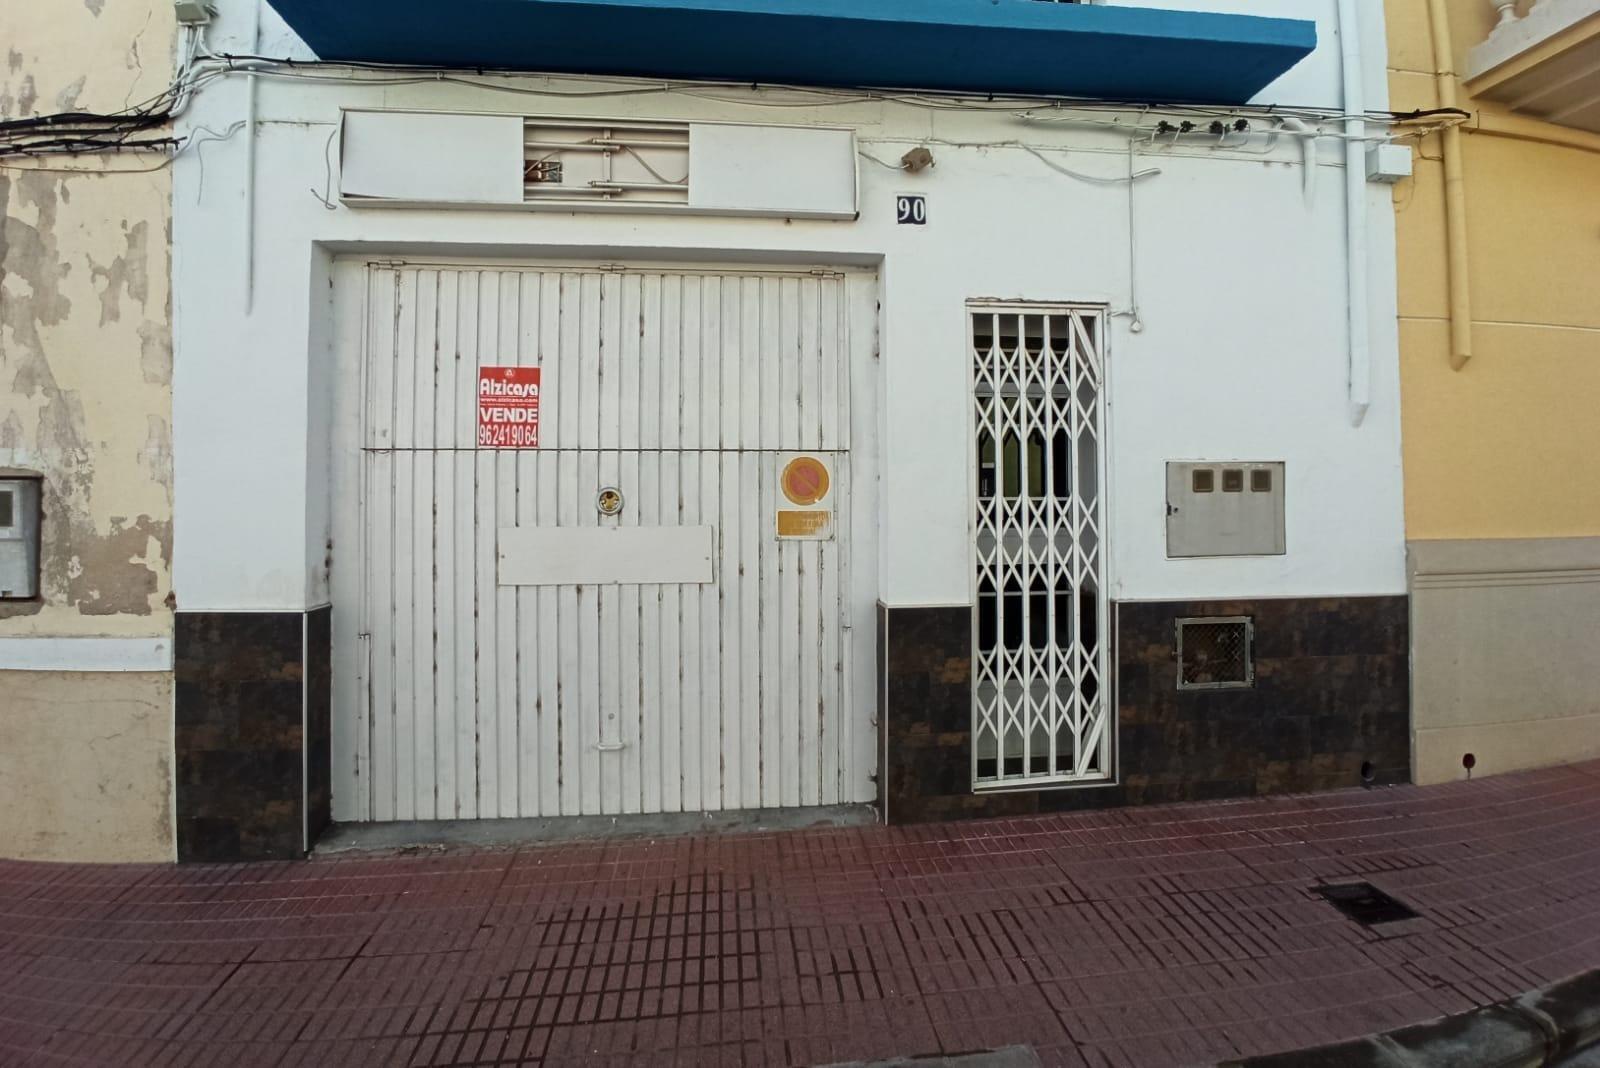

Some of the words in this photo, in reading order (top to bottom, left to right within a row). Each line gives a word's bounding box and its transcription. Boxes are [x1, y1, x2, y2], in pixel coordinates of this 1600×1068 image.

[899, 198, 925, 221] 90
[480, 378, 538, 397] Alzicasa
[480, 407, 538, 423] VENDE
[479, 424, 537, 445] 962419064
